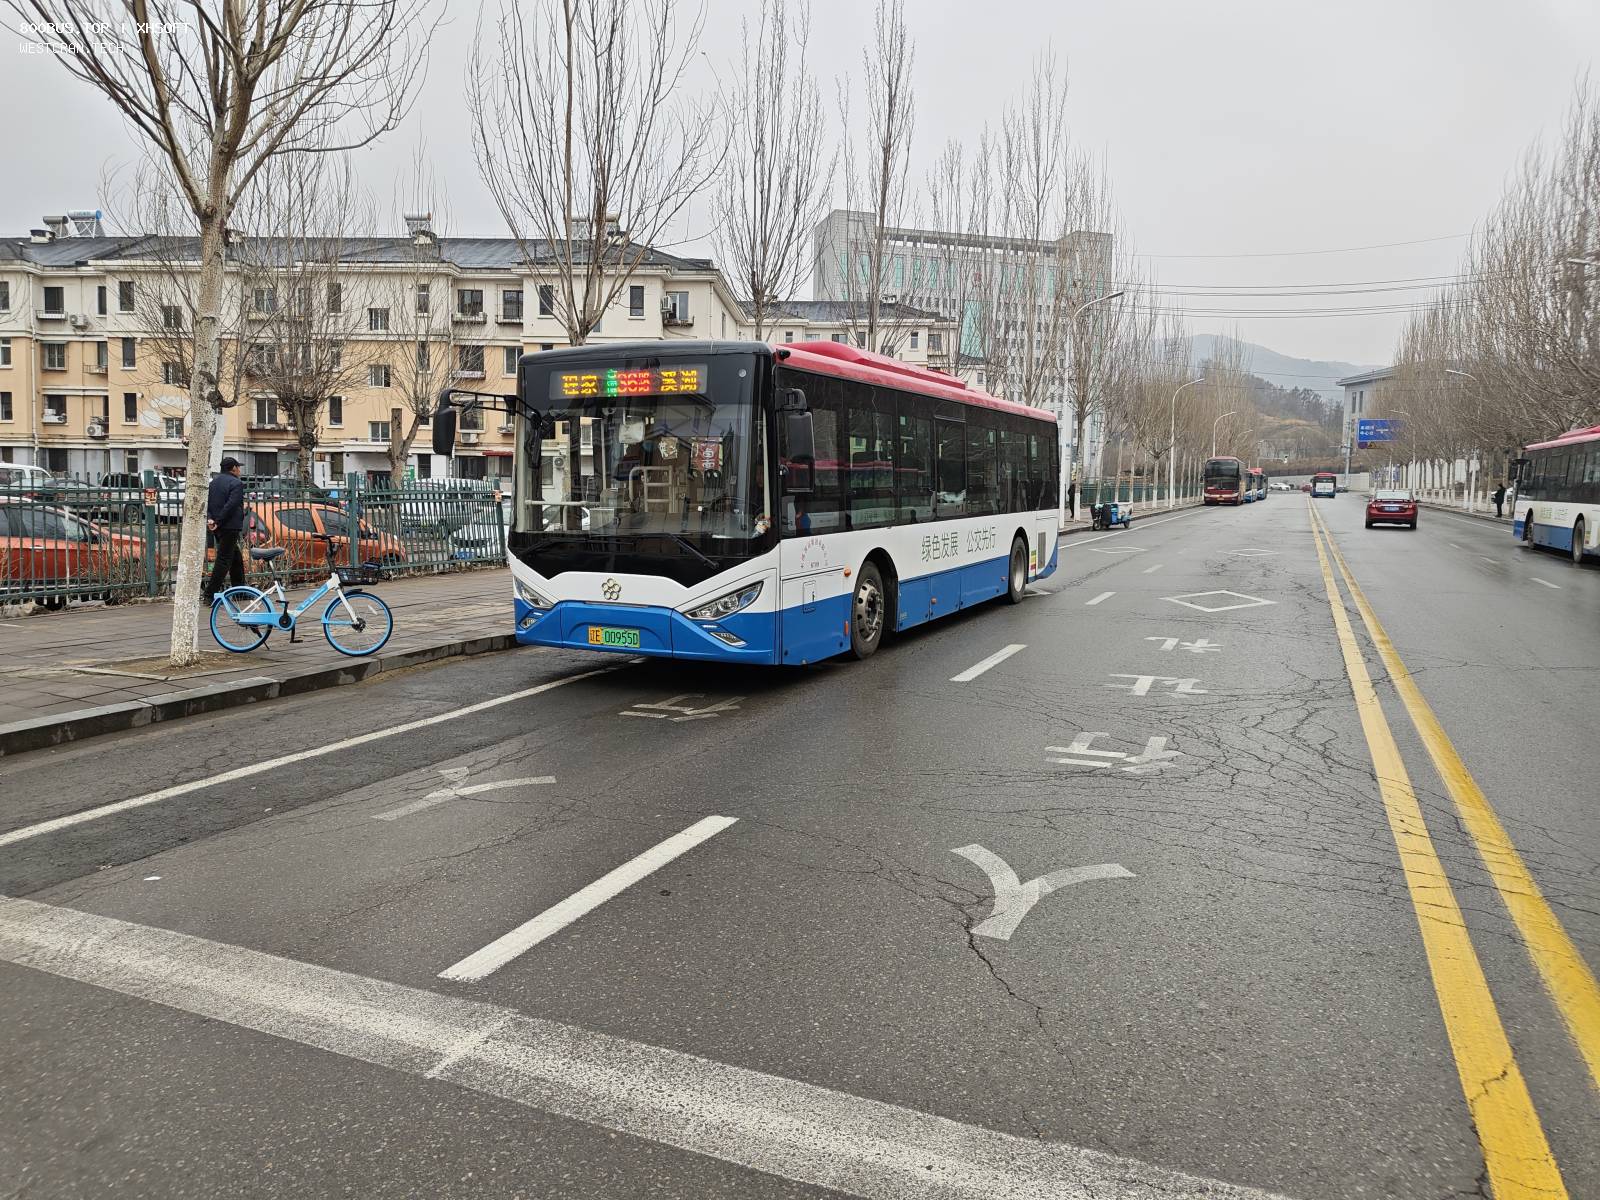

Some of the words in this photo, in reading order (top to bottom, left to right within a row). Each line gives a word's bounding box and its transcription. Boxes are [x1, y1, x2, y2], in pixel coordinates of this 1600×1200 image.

[921, 531, 959, 562] 绿色发展
[967, 525, 996, 553] 公交先行
